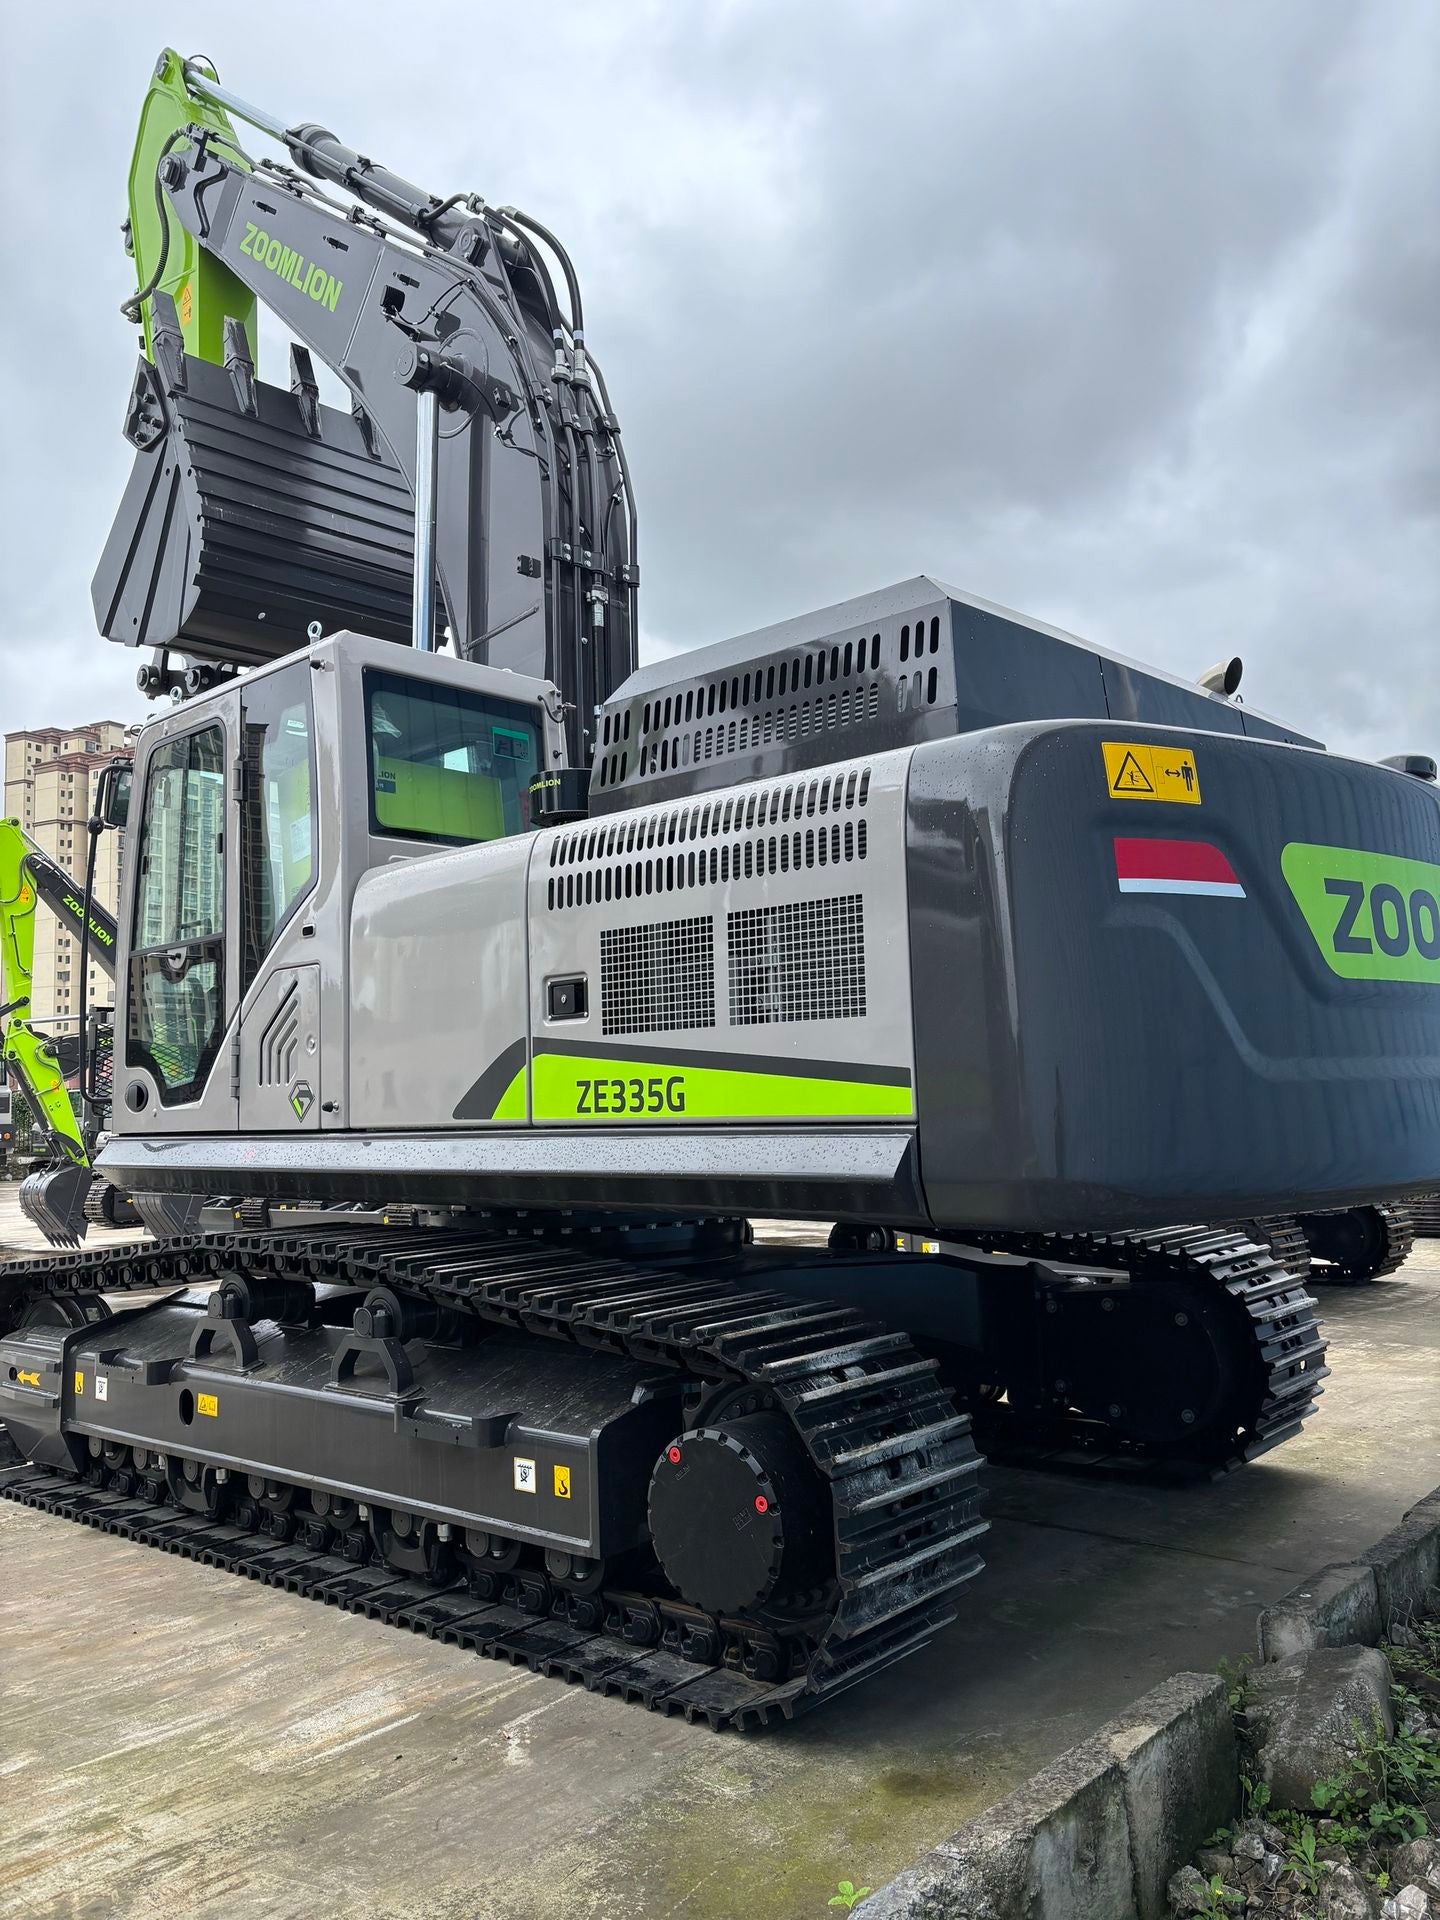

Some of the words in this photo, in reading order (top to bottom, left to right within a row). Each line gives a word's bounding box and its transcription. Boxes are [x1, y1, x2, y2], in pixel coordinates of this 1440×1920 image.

[239, 221, 343, 313] ZOOMLION
[1323, 877, 1440, 961] ZOO
[576, 1076, 686, 1113] ZE335G
